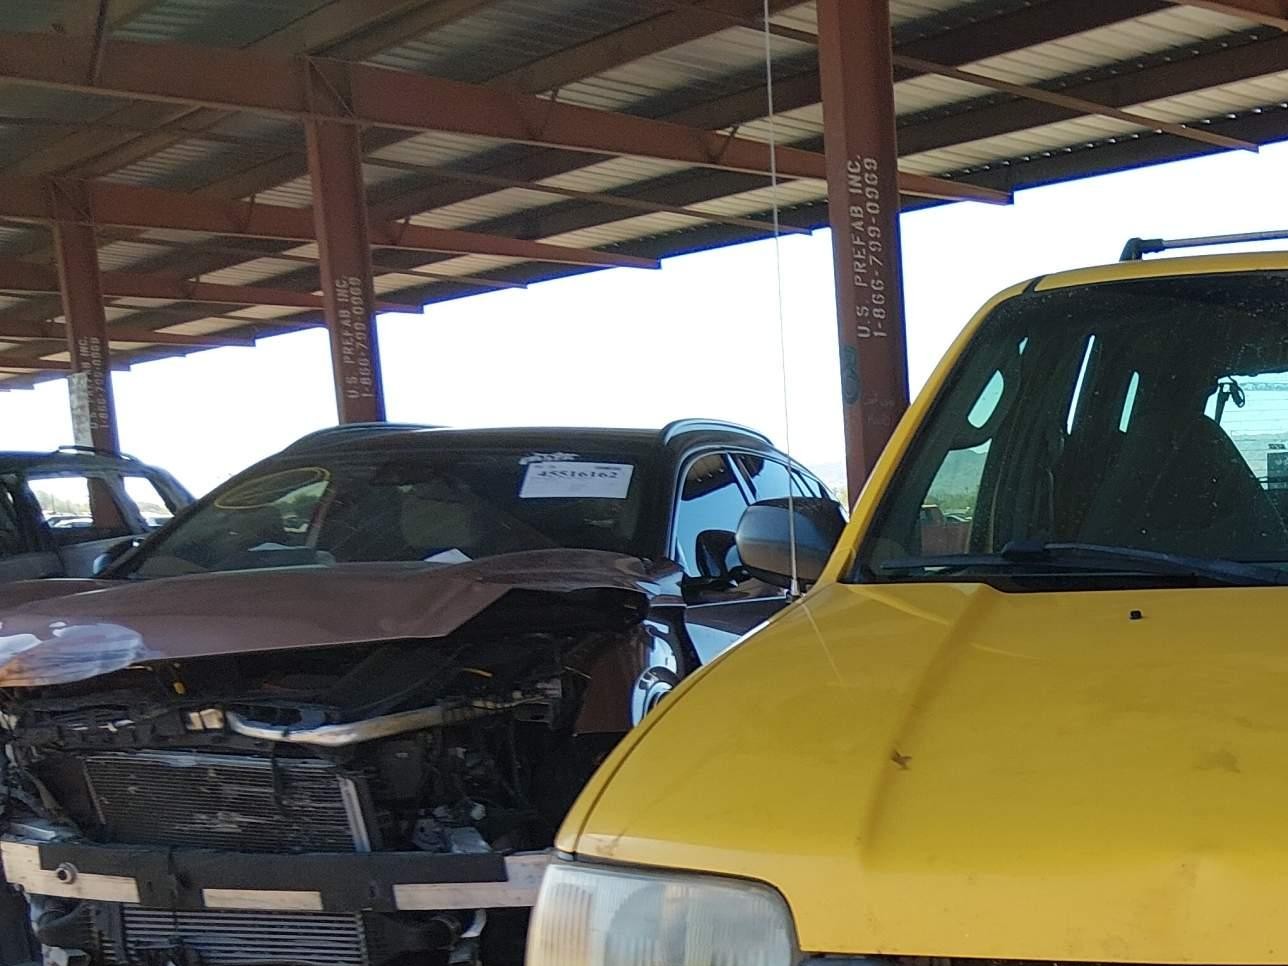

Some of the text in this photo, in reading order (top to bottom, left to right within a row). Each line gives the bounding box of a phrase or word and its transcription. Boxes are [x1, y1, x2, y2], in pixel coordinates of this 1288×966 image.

[847, 155, 862, 193] INC.
[850, 206, 868, 287] PREFAB
[864, 157, 887, 338] 1-866-799-0969
[338, 309, 356, 365] PREFAB
